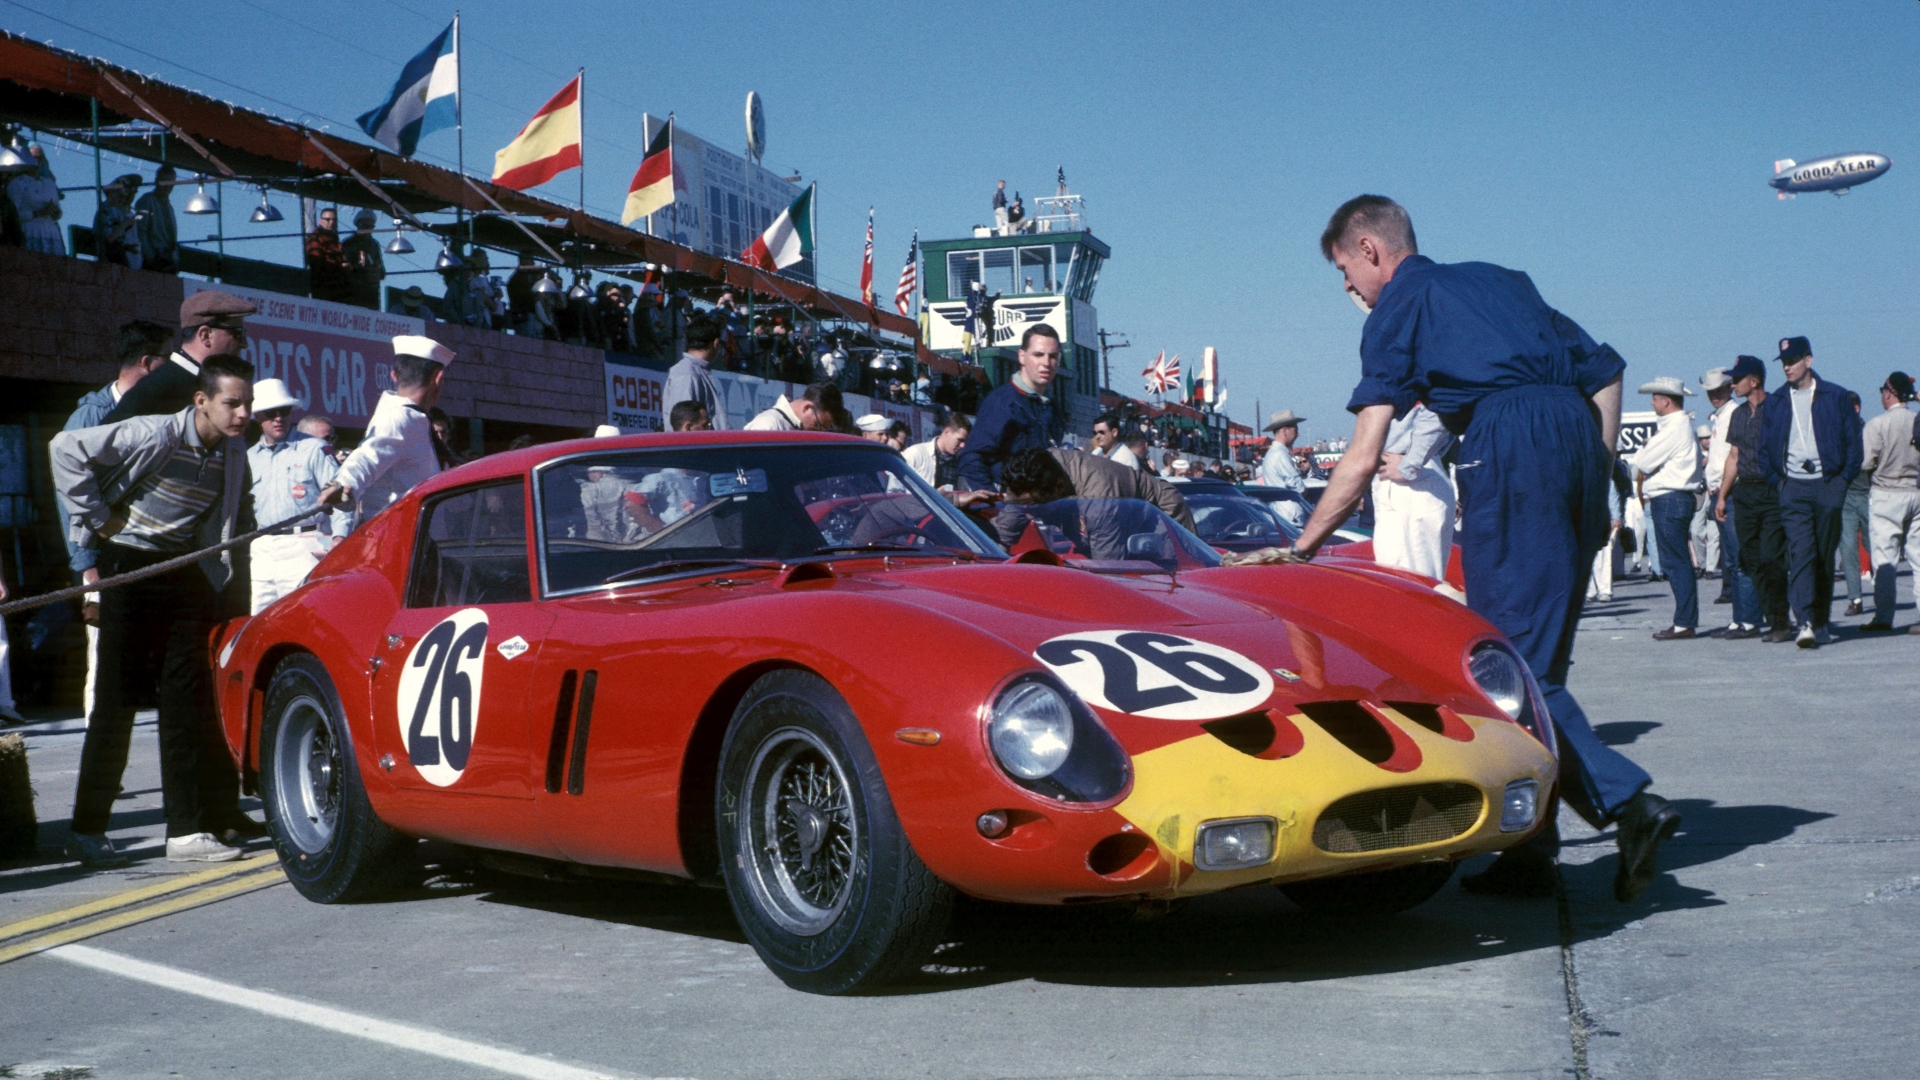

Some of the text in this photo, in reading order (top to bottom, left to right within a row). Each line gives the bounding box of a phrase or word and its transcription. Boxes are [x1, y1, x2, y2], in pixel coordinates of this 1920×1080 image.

[268, 300, 295, 320] SCENE
[298, 305, 318, 324] WITH
[320, 309, 371, 333] WORLD-WIDE
[997, 308, 1023, 326] UAR
[320, 347, 368, 416] CAR
[613, 374, 663, 412] COBR
[408, 619, 489, 772] 26
[1035, 632, 1260, 714] 26
